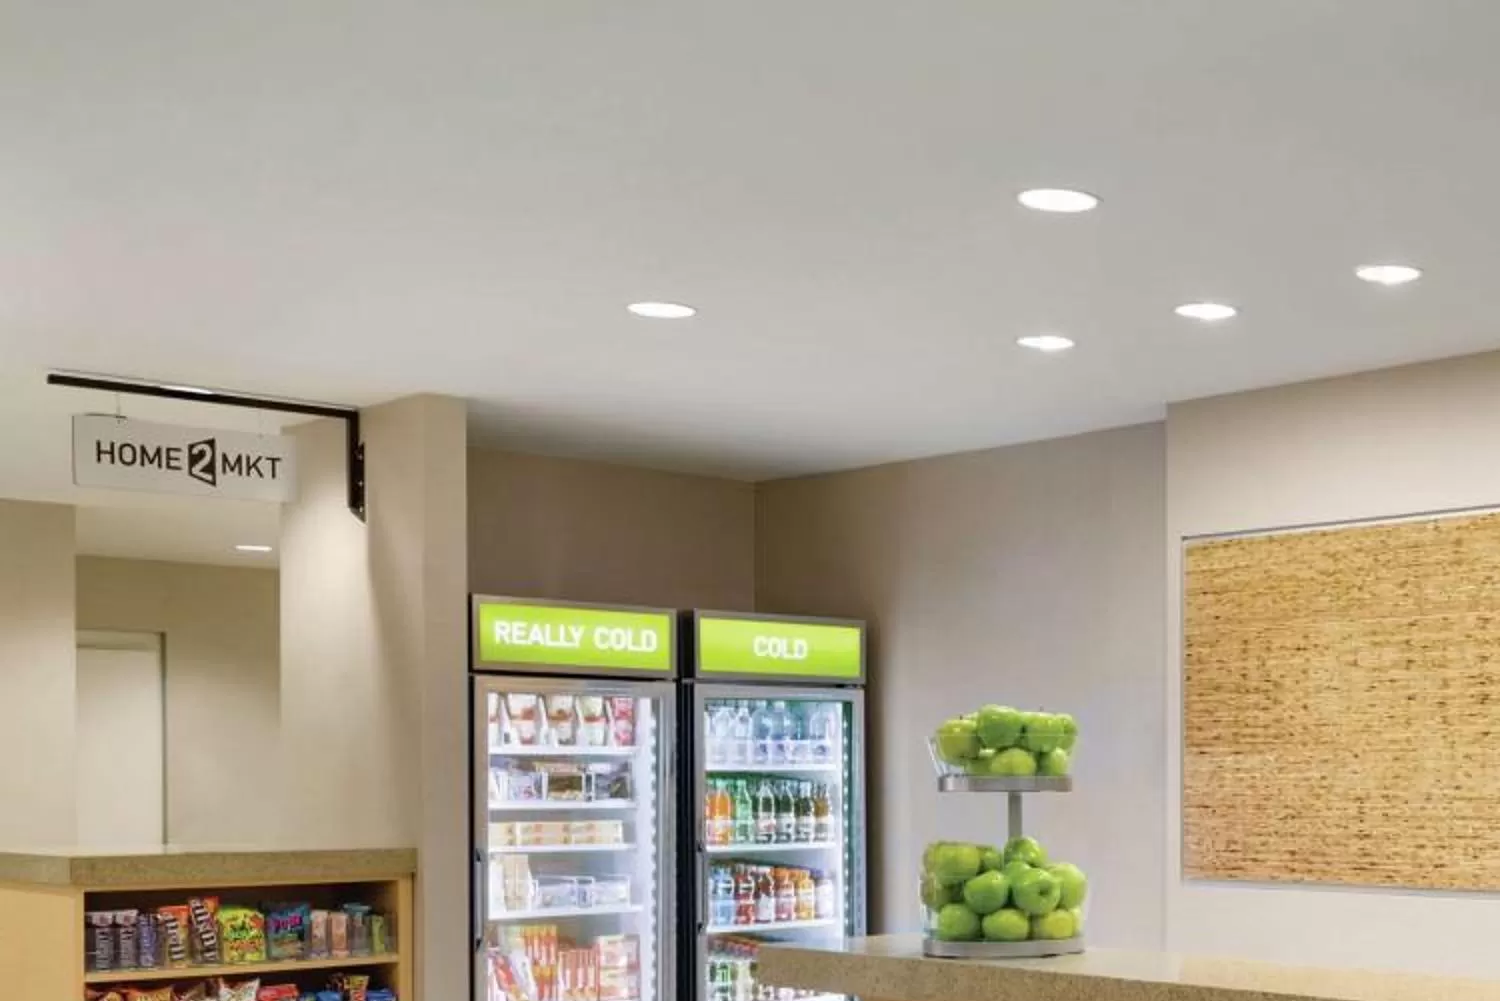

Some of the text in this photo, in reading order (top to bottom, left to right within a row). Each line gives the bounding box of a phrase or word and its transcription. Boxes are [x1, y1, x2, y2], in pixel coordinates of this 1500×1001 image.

[493, 620, 658, 653] REALLY COLD
[753, 634, 808, 660] COLD
